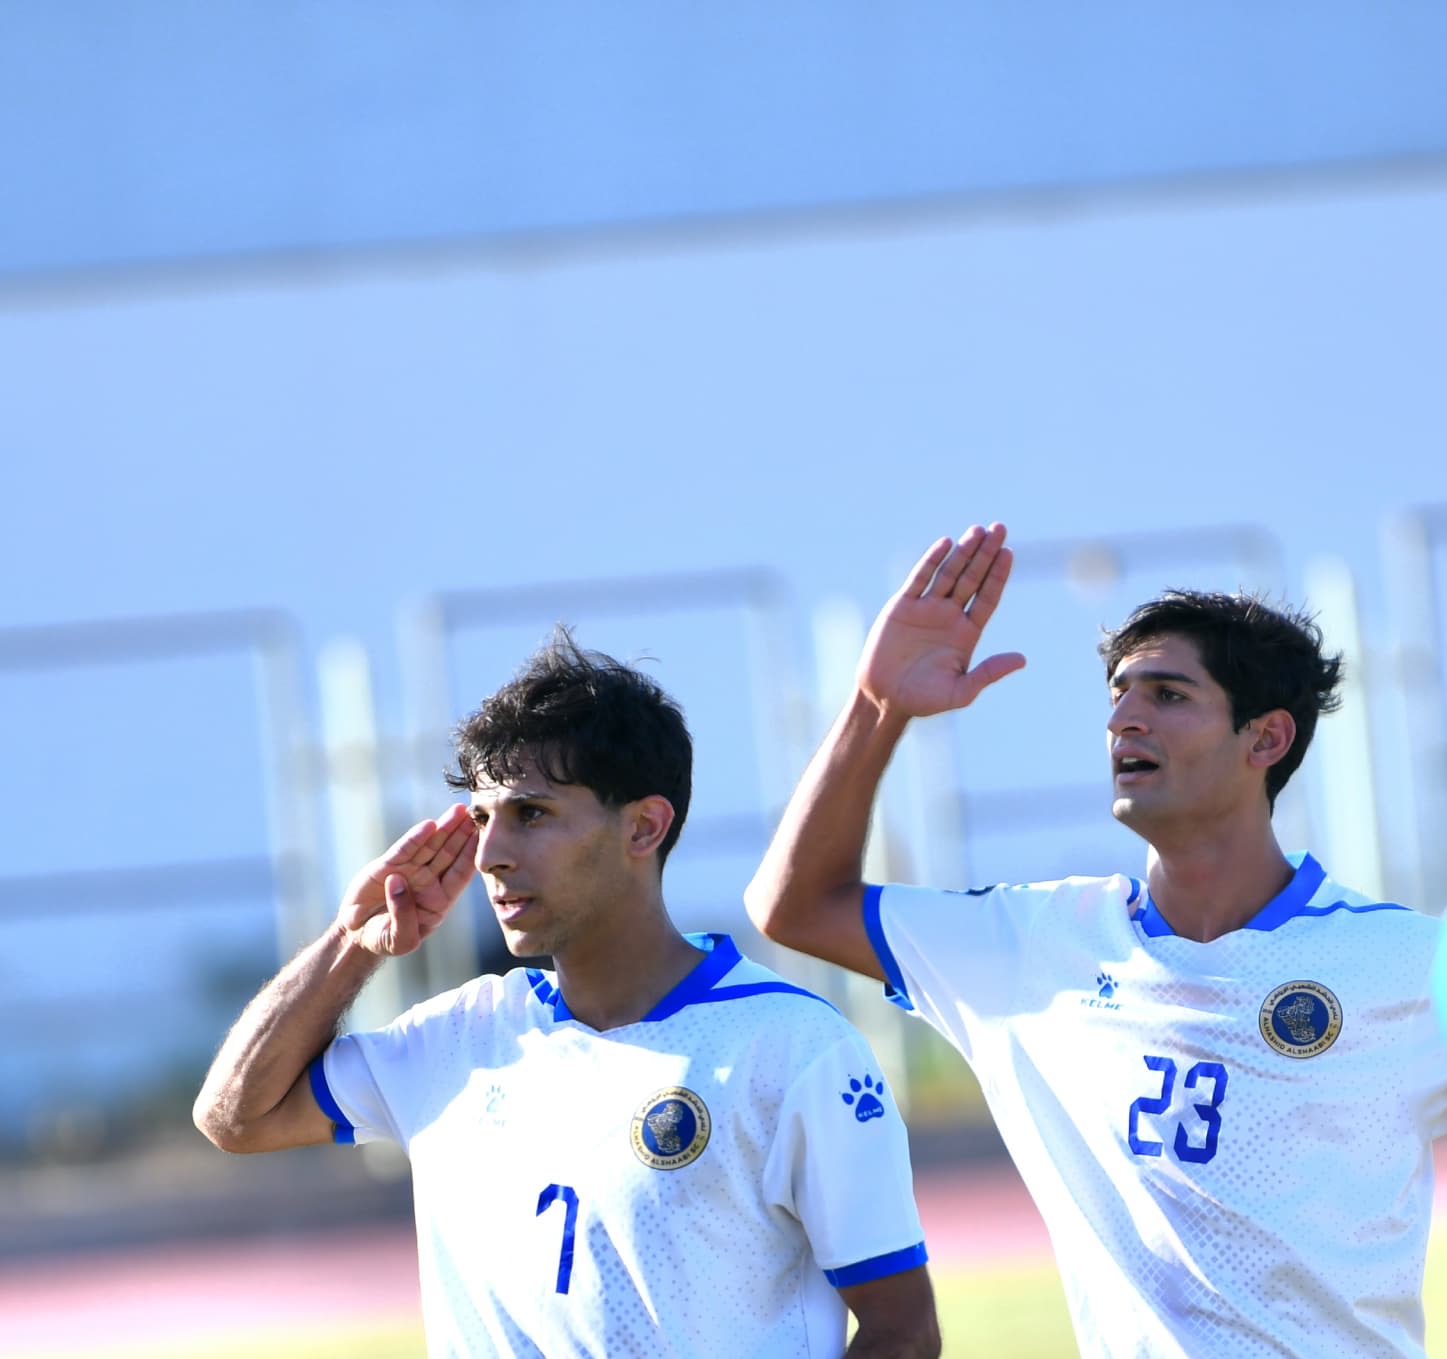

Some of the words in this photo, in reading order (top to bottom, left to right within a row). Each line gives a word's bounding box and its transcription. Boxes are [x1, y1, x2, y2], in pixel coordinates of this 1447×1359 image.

[1263, 1016, 1286, 1050] ALHASHID
[1287, 1041, 1327, 1055] ALSHAABI
[1128, 1054, 1229, 1165] 23
[535, 1183, 580, 1295] 7
